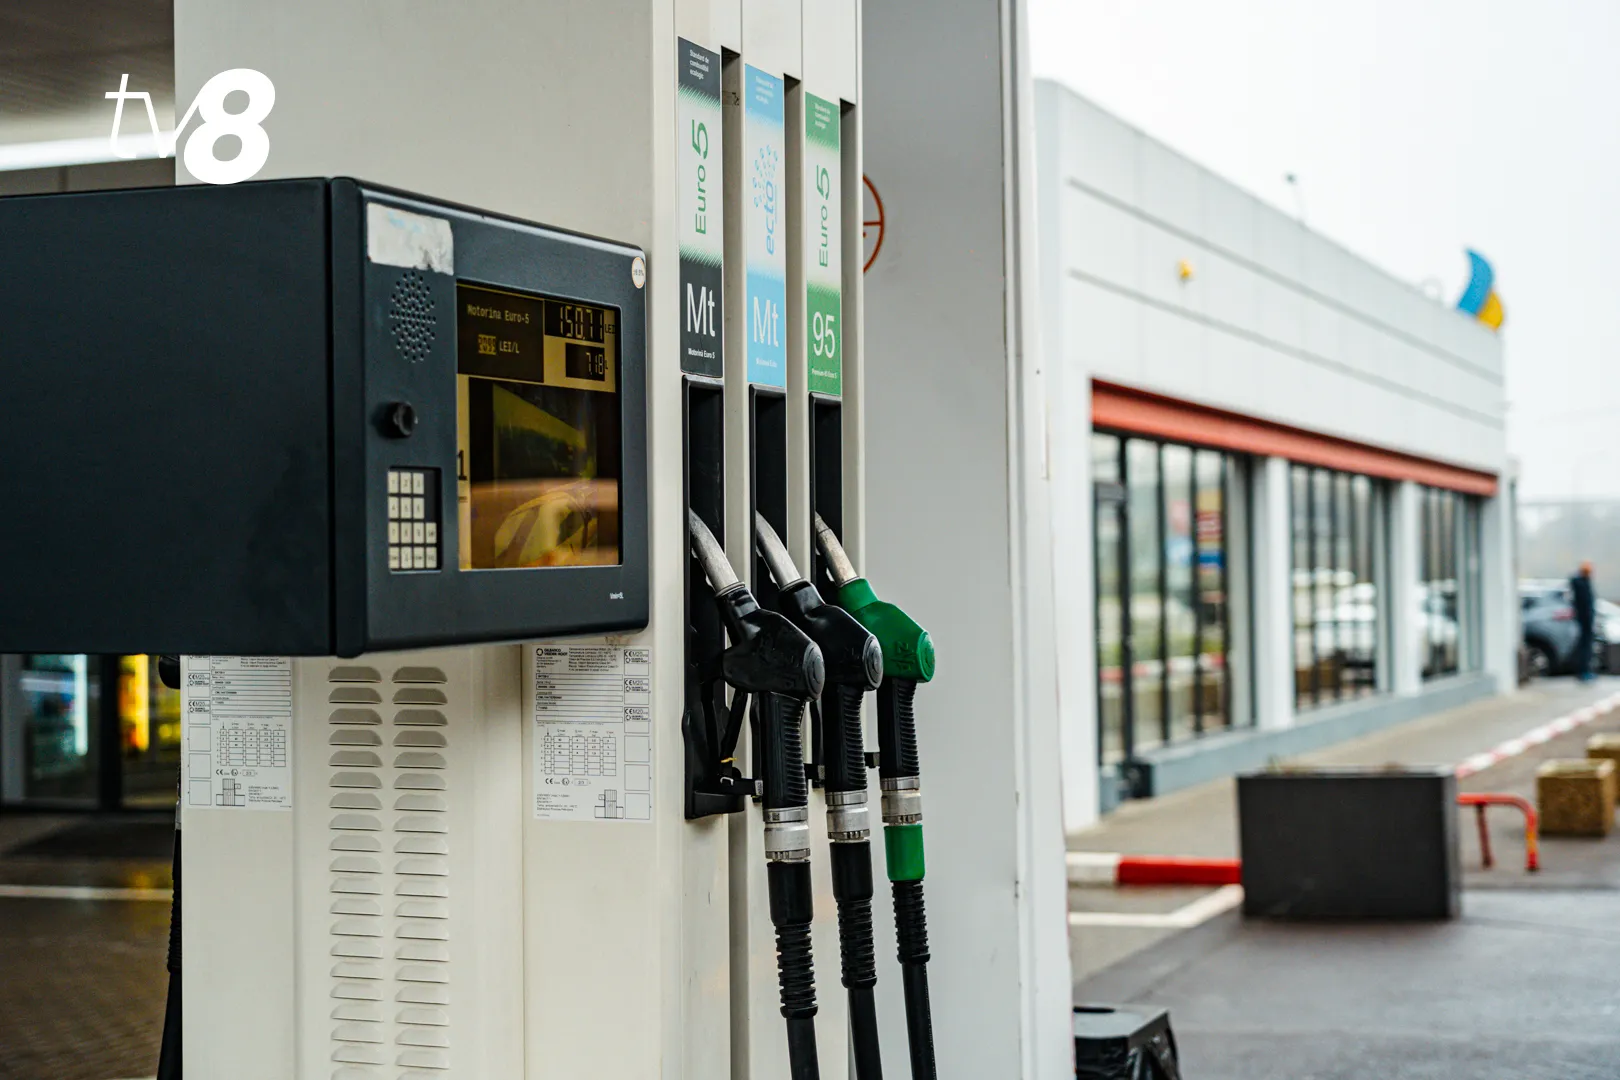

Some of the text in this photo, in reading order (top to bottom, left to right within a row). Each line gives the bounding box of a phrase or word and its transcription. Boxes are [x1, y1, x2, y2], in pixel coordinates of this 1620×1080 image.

[691, 119, 709, 235] Euro 5
[764, 179, 775, 256] ecto
[816, 164, 830, 268] Euro 5
[466, 303, 530, 325] Motorina Euro-5
[687, 282, 716, 338] Mt
[753, 296, 779, 348] Mt
[813, 311, 836, 359] 95
[500, 340, 520, 354] LEI/L
